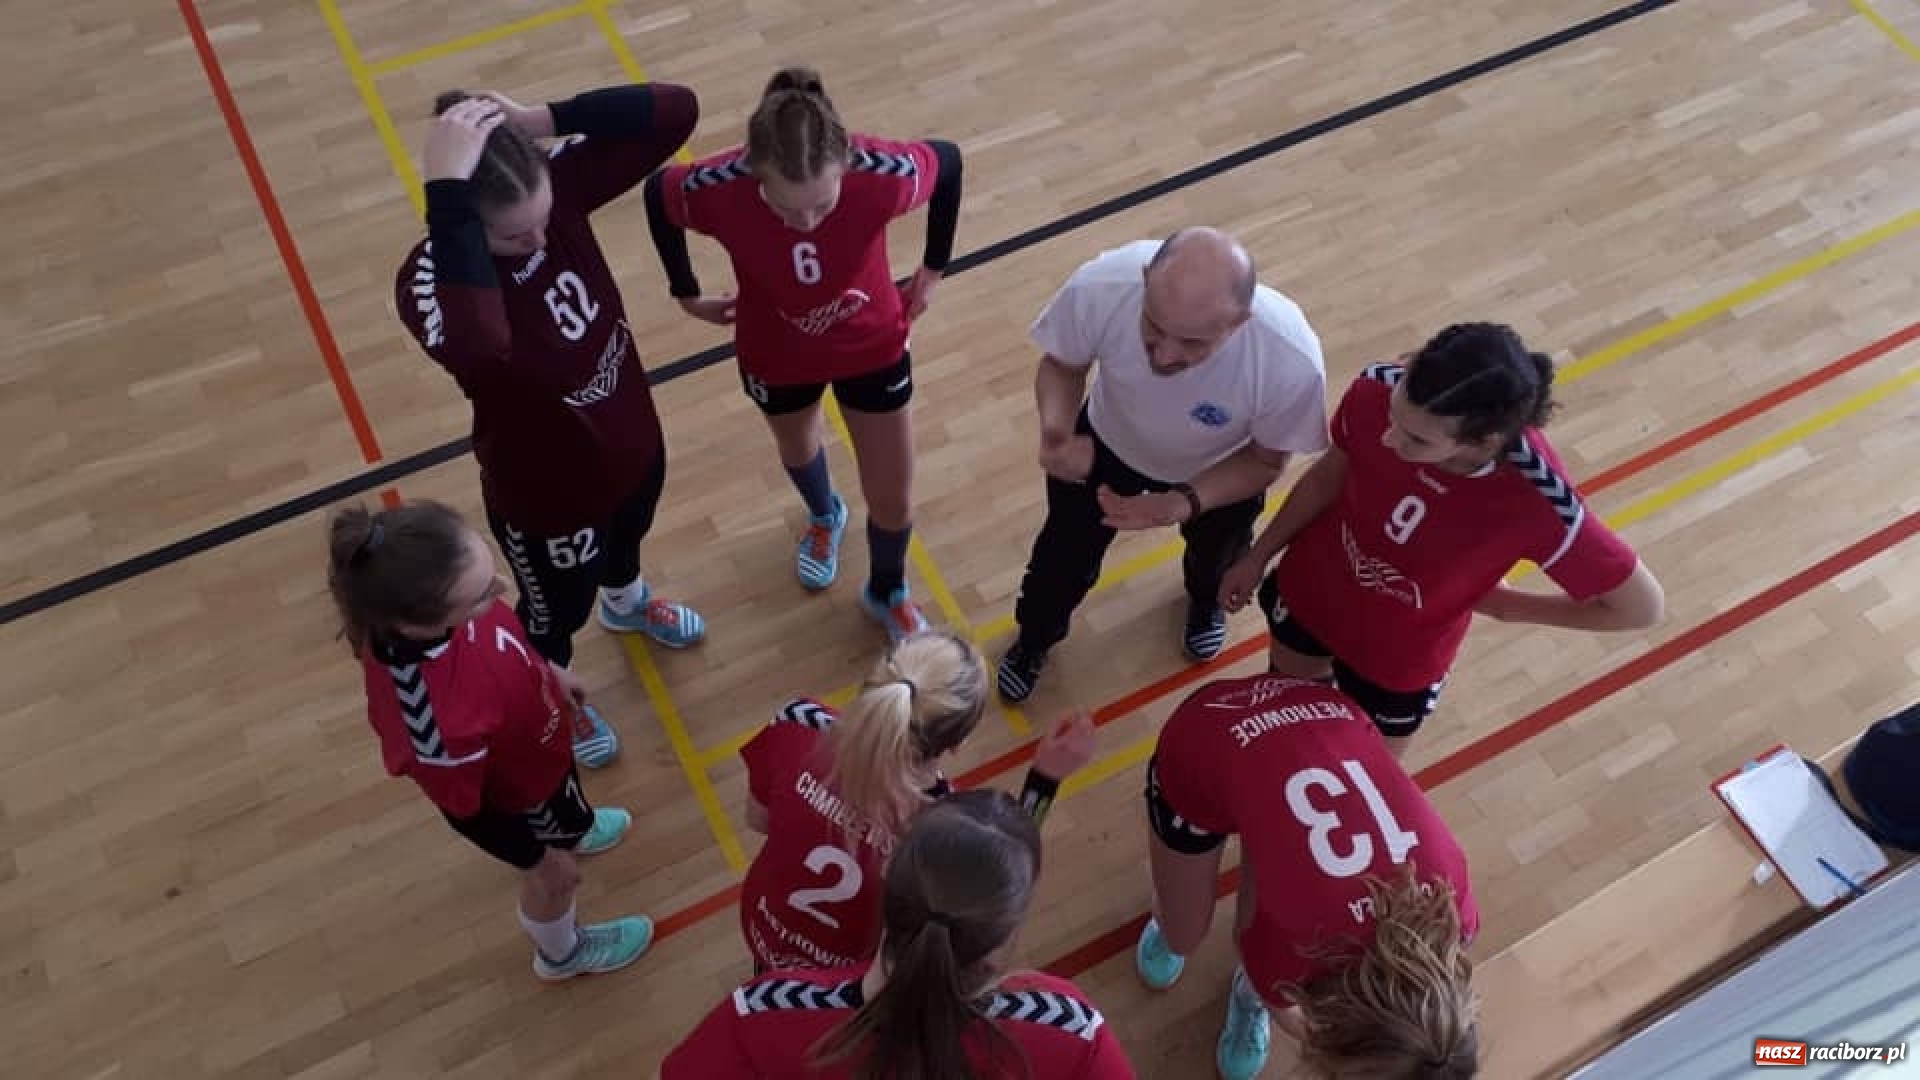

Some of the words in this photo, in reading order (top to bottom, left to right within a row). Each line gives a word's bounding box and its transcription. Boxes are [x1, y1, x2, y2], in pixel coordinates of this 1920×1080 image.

[792, 241, 823, 284] 6
[543, 271, 600, 340] 52
[1384, 495, 1427, 545] 9
[546, 527, 600, 569] 52
[496, 626, 532, 666] 7
[1285, 760, 1420, 878] 13
[787, 846, 864, 929] 2
